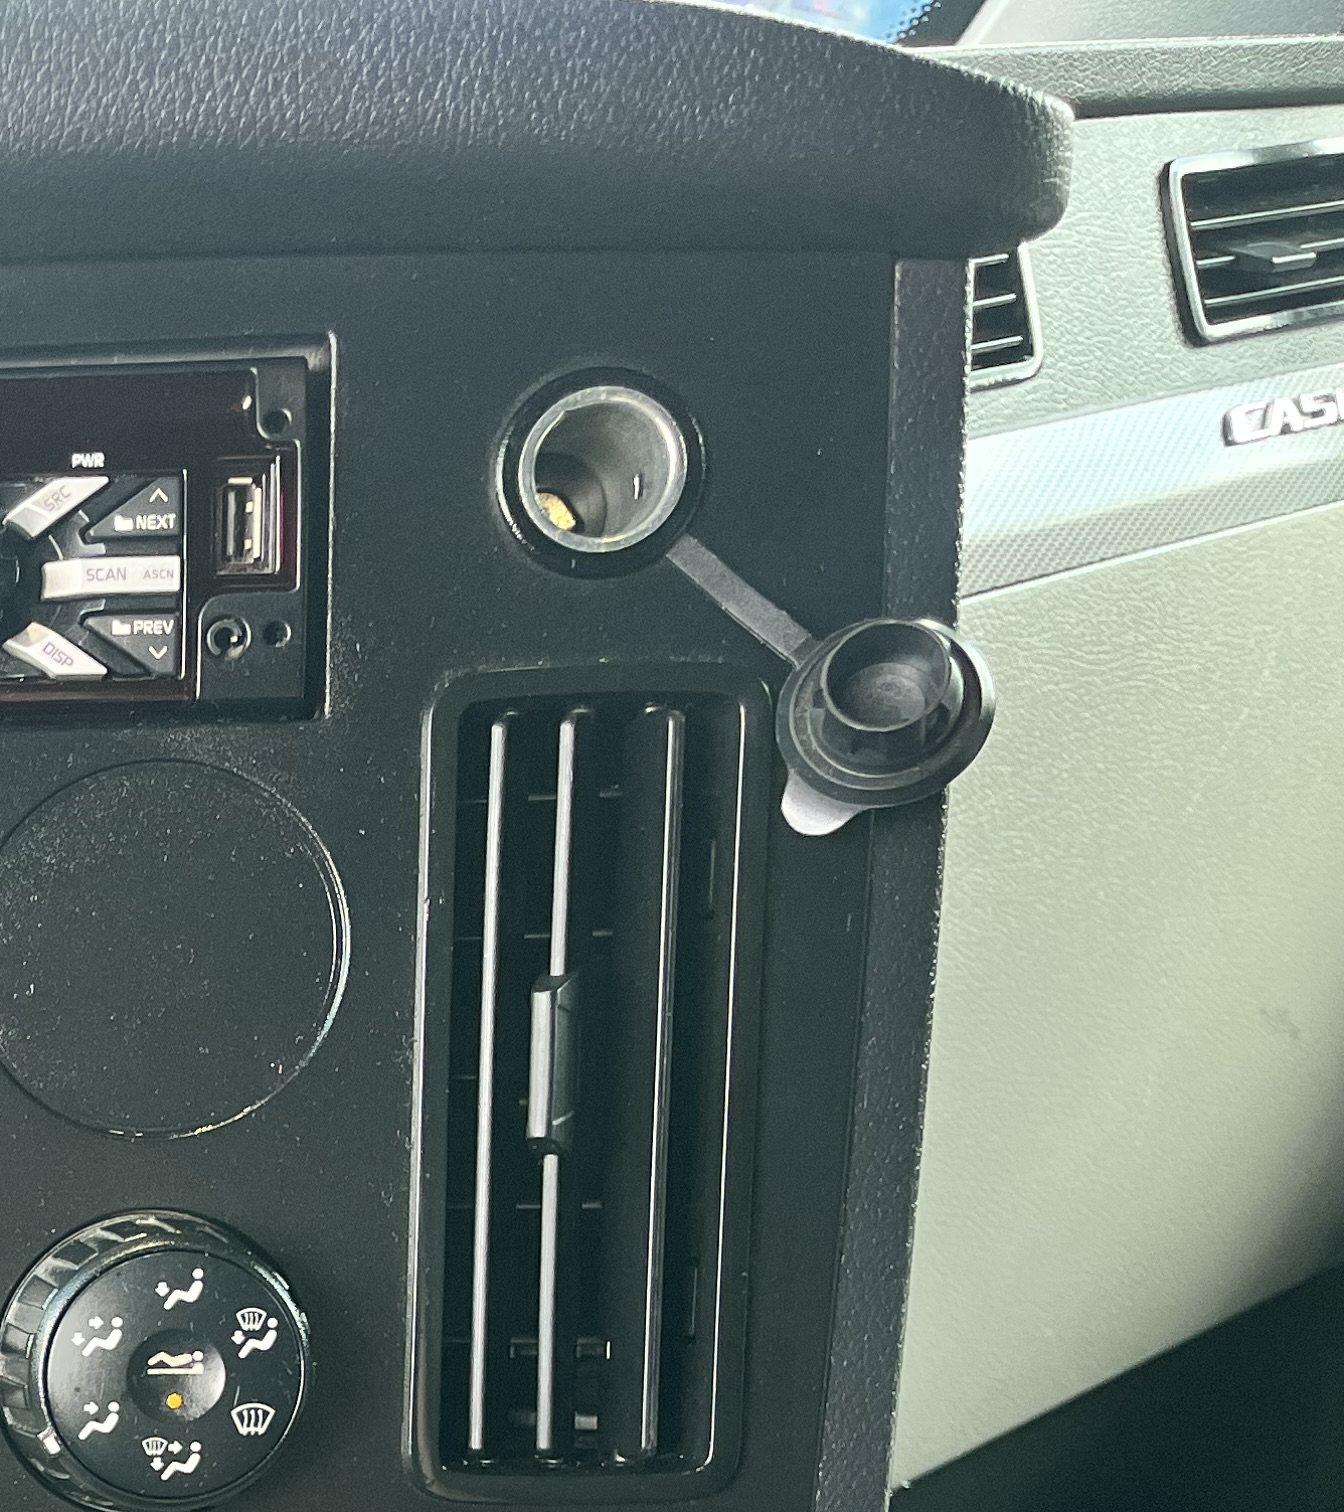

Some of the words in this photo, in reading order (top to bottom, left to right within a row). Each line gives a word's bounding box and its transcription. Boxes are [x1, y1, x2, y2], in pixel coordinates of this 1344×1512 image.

[71, 452, 105, 469] PWR
[44, 485, 72, 512] SRC
[135, 514, 176, 530] NEXT
[85, 567, 127, 582] SCAN
[142, 568, 175, 580] ASCN
[133, 619, 175, 635] PREV
[42, 640, 74, 668] DISP
